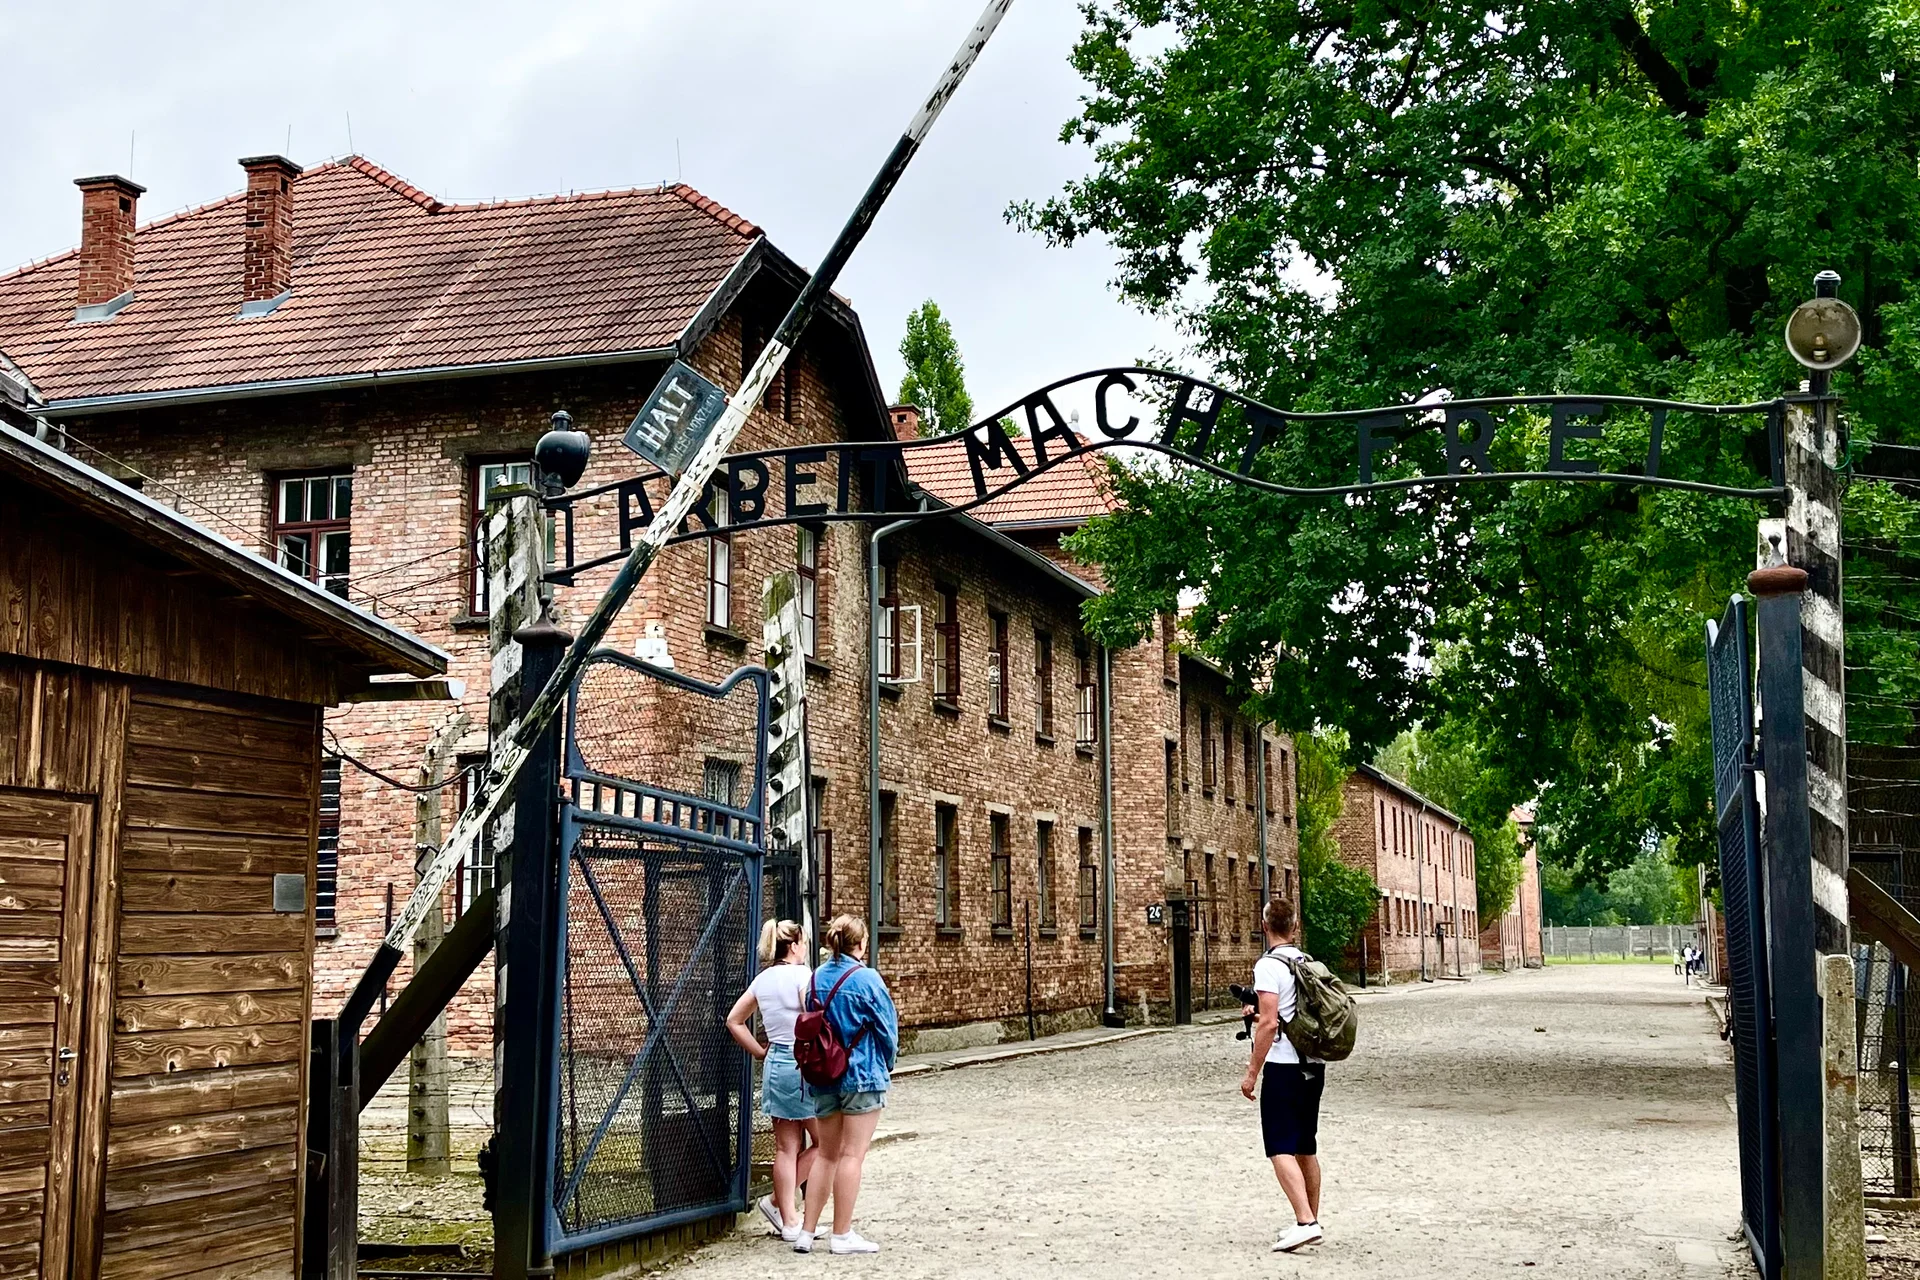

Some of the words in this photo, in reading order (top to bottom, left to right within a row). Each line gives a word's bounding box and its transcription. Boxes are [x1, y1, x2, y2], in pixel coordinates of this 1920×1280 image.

[635, 376, 695, 450] HALT
[619, 446, 902, 552] ARBEIT
[963, 373, 1285, 498] MACHT
[1358, 402, 1667, 485] FREI
[1149, 906, 1162, 918] 24
